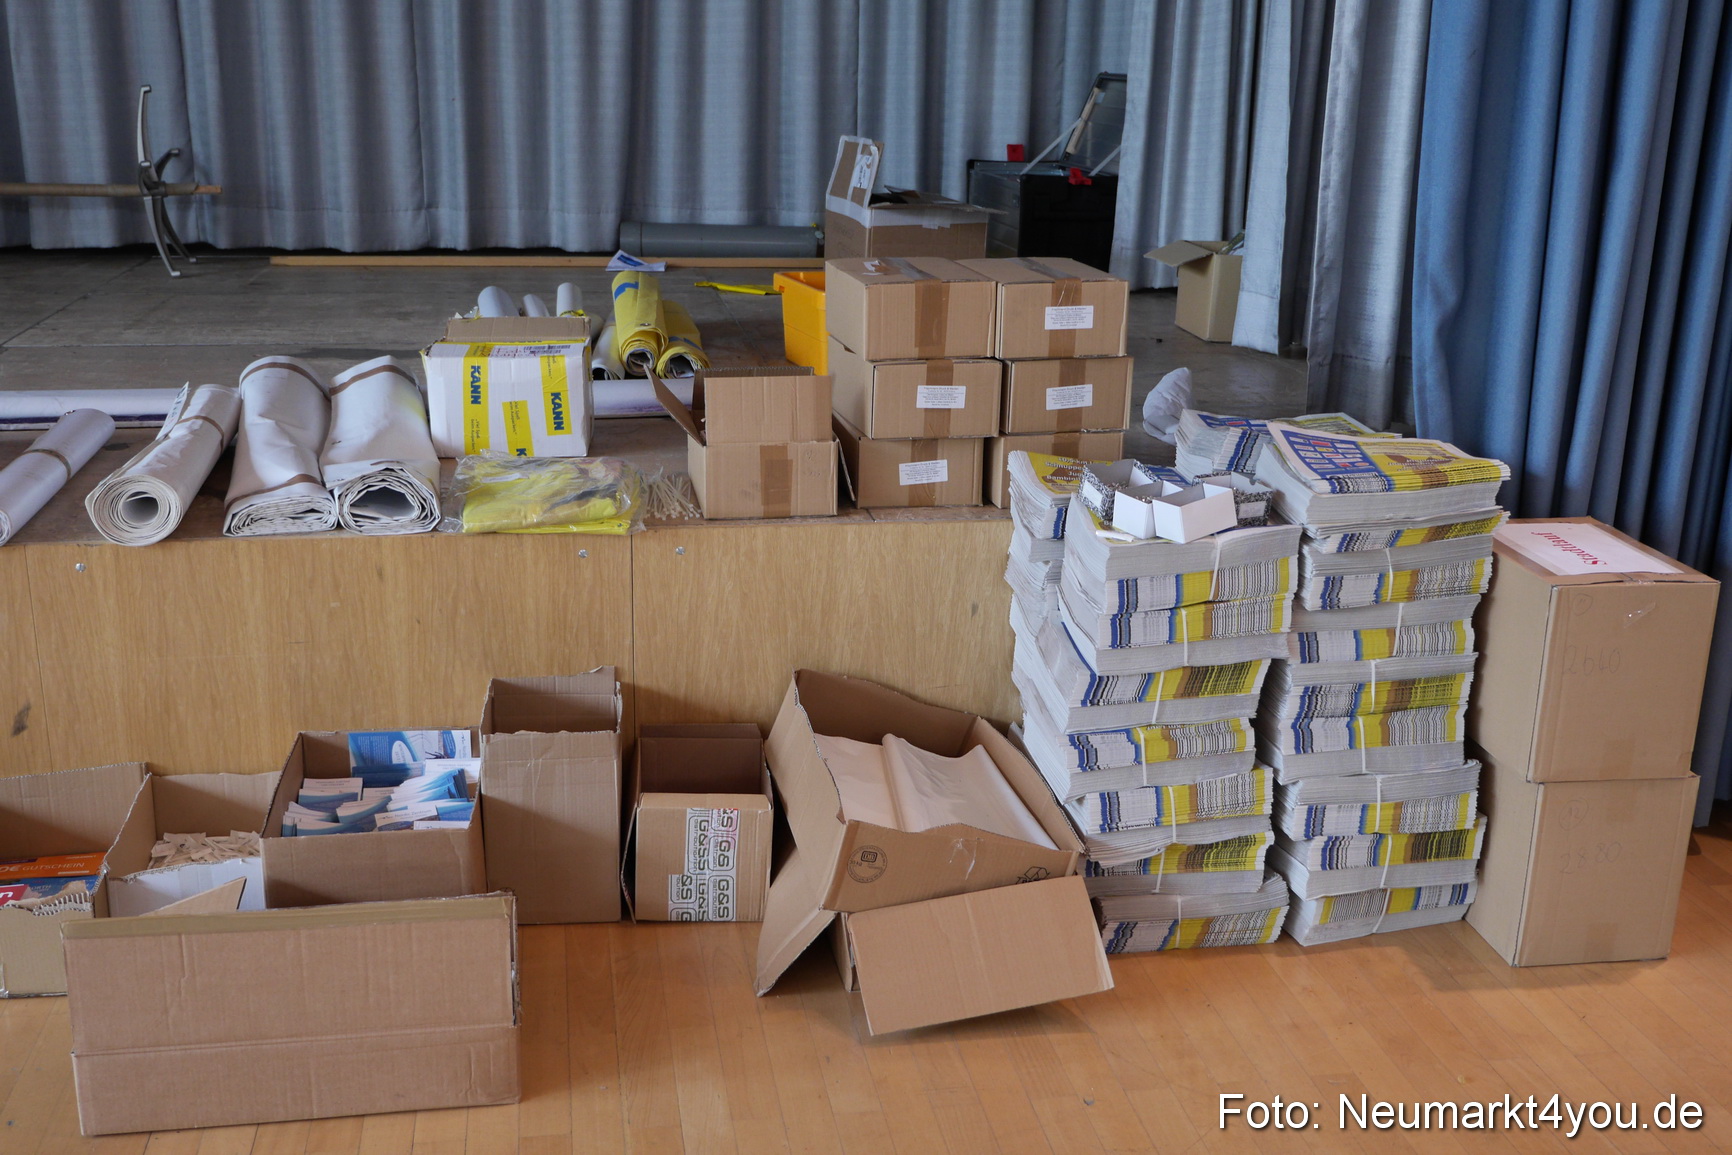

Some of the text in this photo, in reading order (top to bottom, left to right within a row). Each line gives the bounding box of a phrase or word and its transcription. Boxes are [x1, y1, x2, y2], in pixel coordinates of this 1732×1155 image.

[470, 365, 481, 404] KANN
[550, 392, 565, 431] KANN
[1045, 460, 1085, 471] Schnuppe
[1530, 532, 1608, 566] Stadtlauf
[718, 879, 730, 919] G&S
